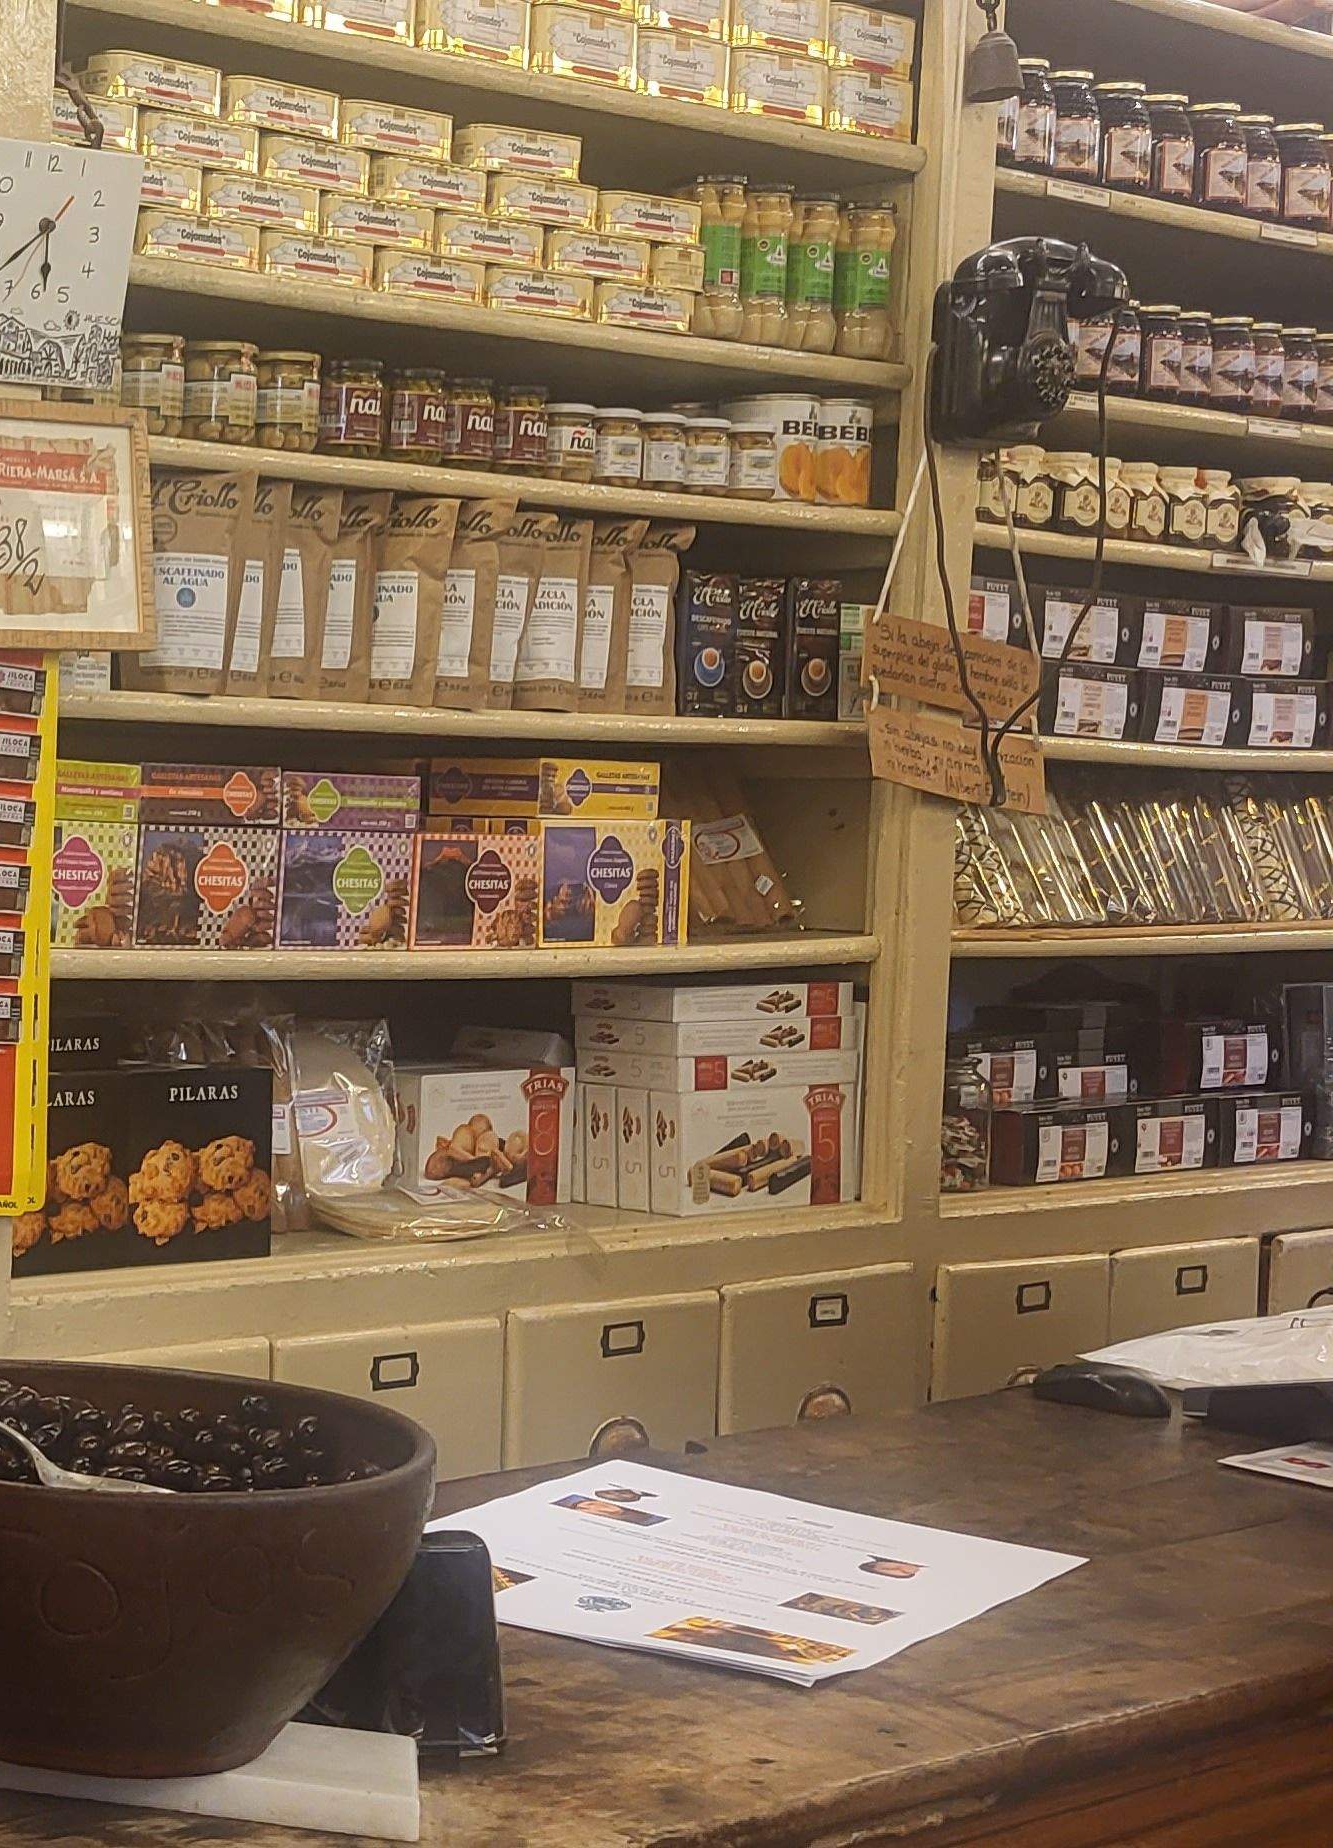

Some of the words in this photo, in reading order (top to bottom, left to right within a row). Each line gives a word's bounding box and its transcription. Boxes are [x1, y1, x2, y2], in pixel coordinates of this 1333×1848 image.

[24, 150, 33, 169] 11
[47, 154, 63, 173] 12
[93, 189, 106, 208] 2
[88, 226, 101, 244] 3
[81, 261, 95, 279] 4
[30, 283, 42, 301] 6
[57, 286, 71, 304] 5
[83, 314, 122, 326] HUESC
[155, 567, 225, 580] ESCAFEINADO
[52, 867, 102, 882] CHESITAS
[590, 866, 632, 879] CHESITAS
[197, 874, 244, 888] CHESITAS
[336, 876, 382, 889] CHESITAS
[468, 878, 510, 891] CHESITAS
[49, 1037, 101, 1052] ILARAS
[168, 1084, 240, 1103] PILARAS
[525, 1079, 565, 1094] TRIAS
[46, 1090, 96, 1108] LARAS
